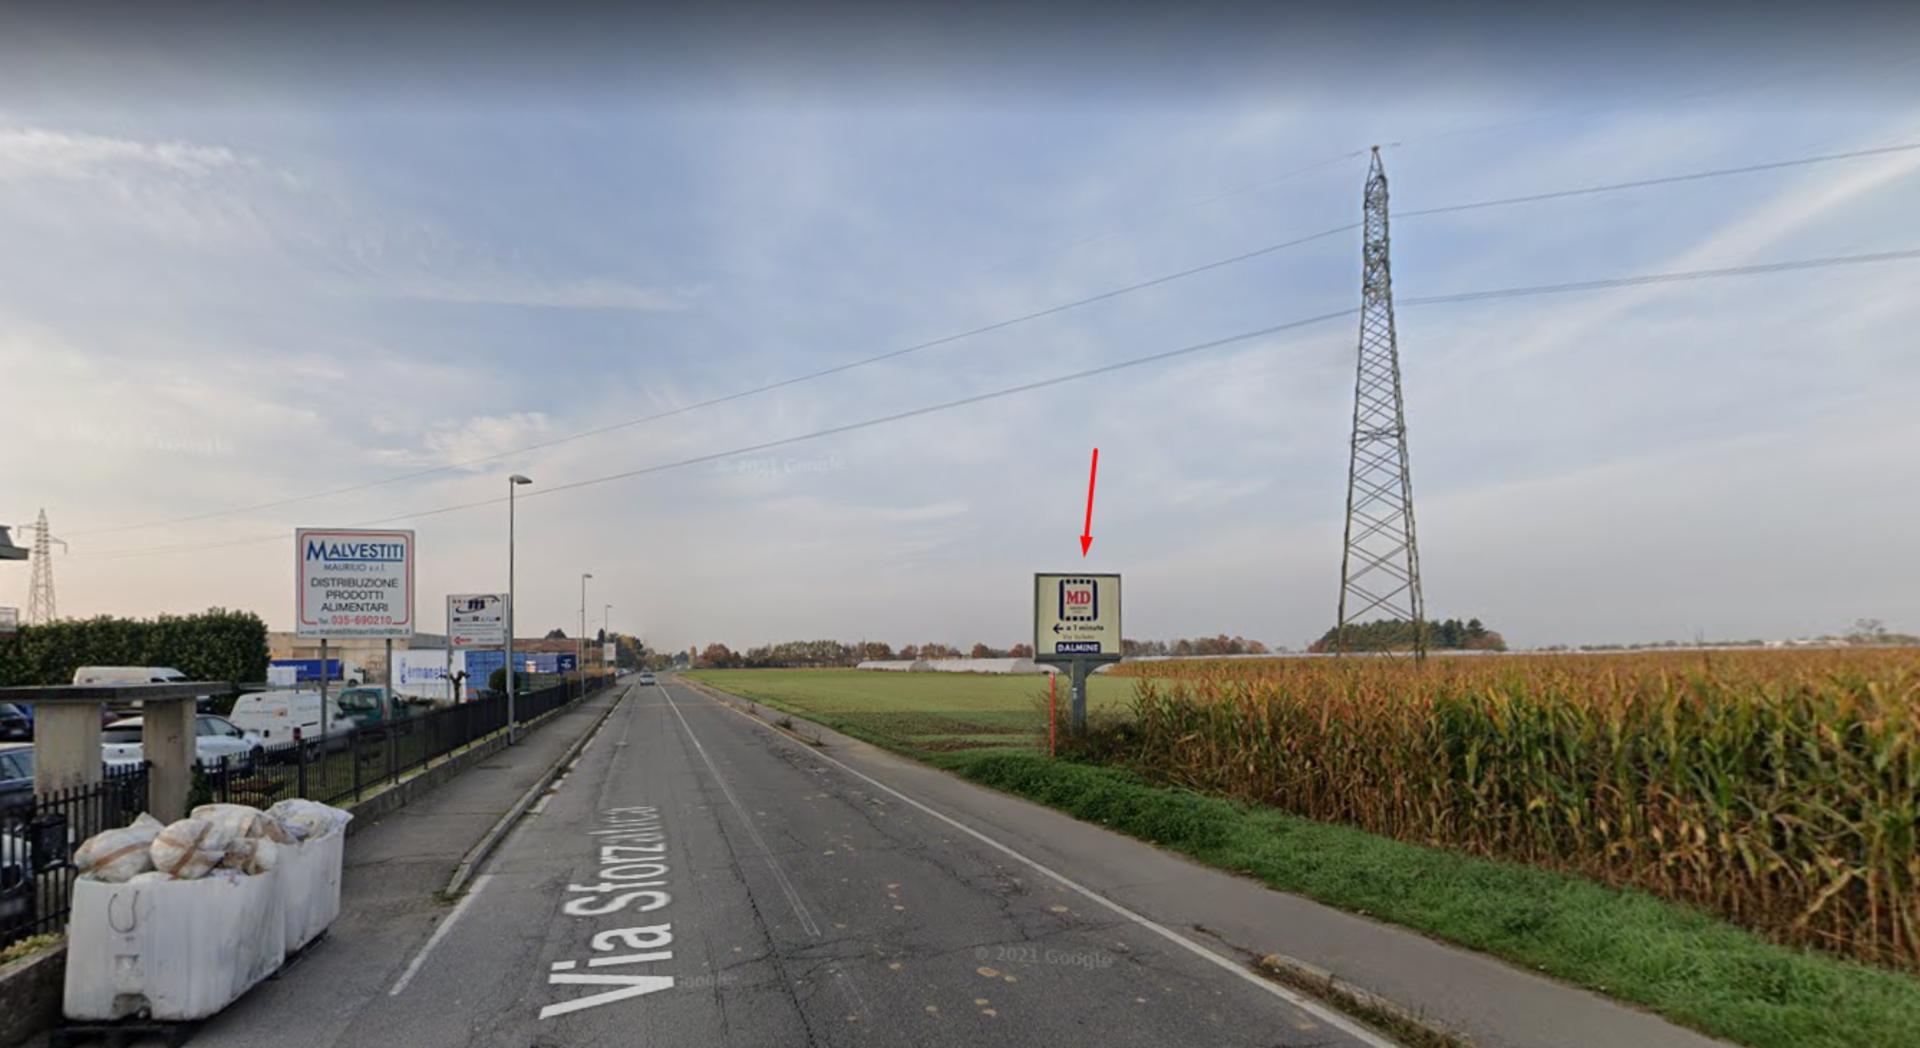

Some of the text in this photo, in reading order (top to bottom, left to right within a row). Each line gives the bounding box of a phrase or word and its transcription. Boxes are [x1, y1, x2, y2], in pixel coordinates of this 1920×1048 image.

[306, 540, 404, 561] MALVESTITI
[310, 577, 399, 588] DISTRIBUZIONE
[325, 590, 384, 600] PRODOTTI
[1066, 590, 1092, 605] MD
[321, 602, 389, 613] ALIMENTARI
[331, 615, 393, 625] 035-690210
[1057, 643, 1099, 652] DALMINE
